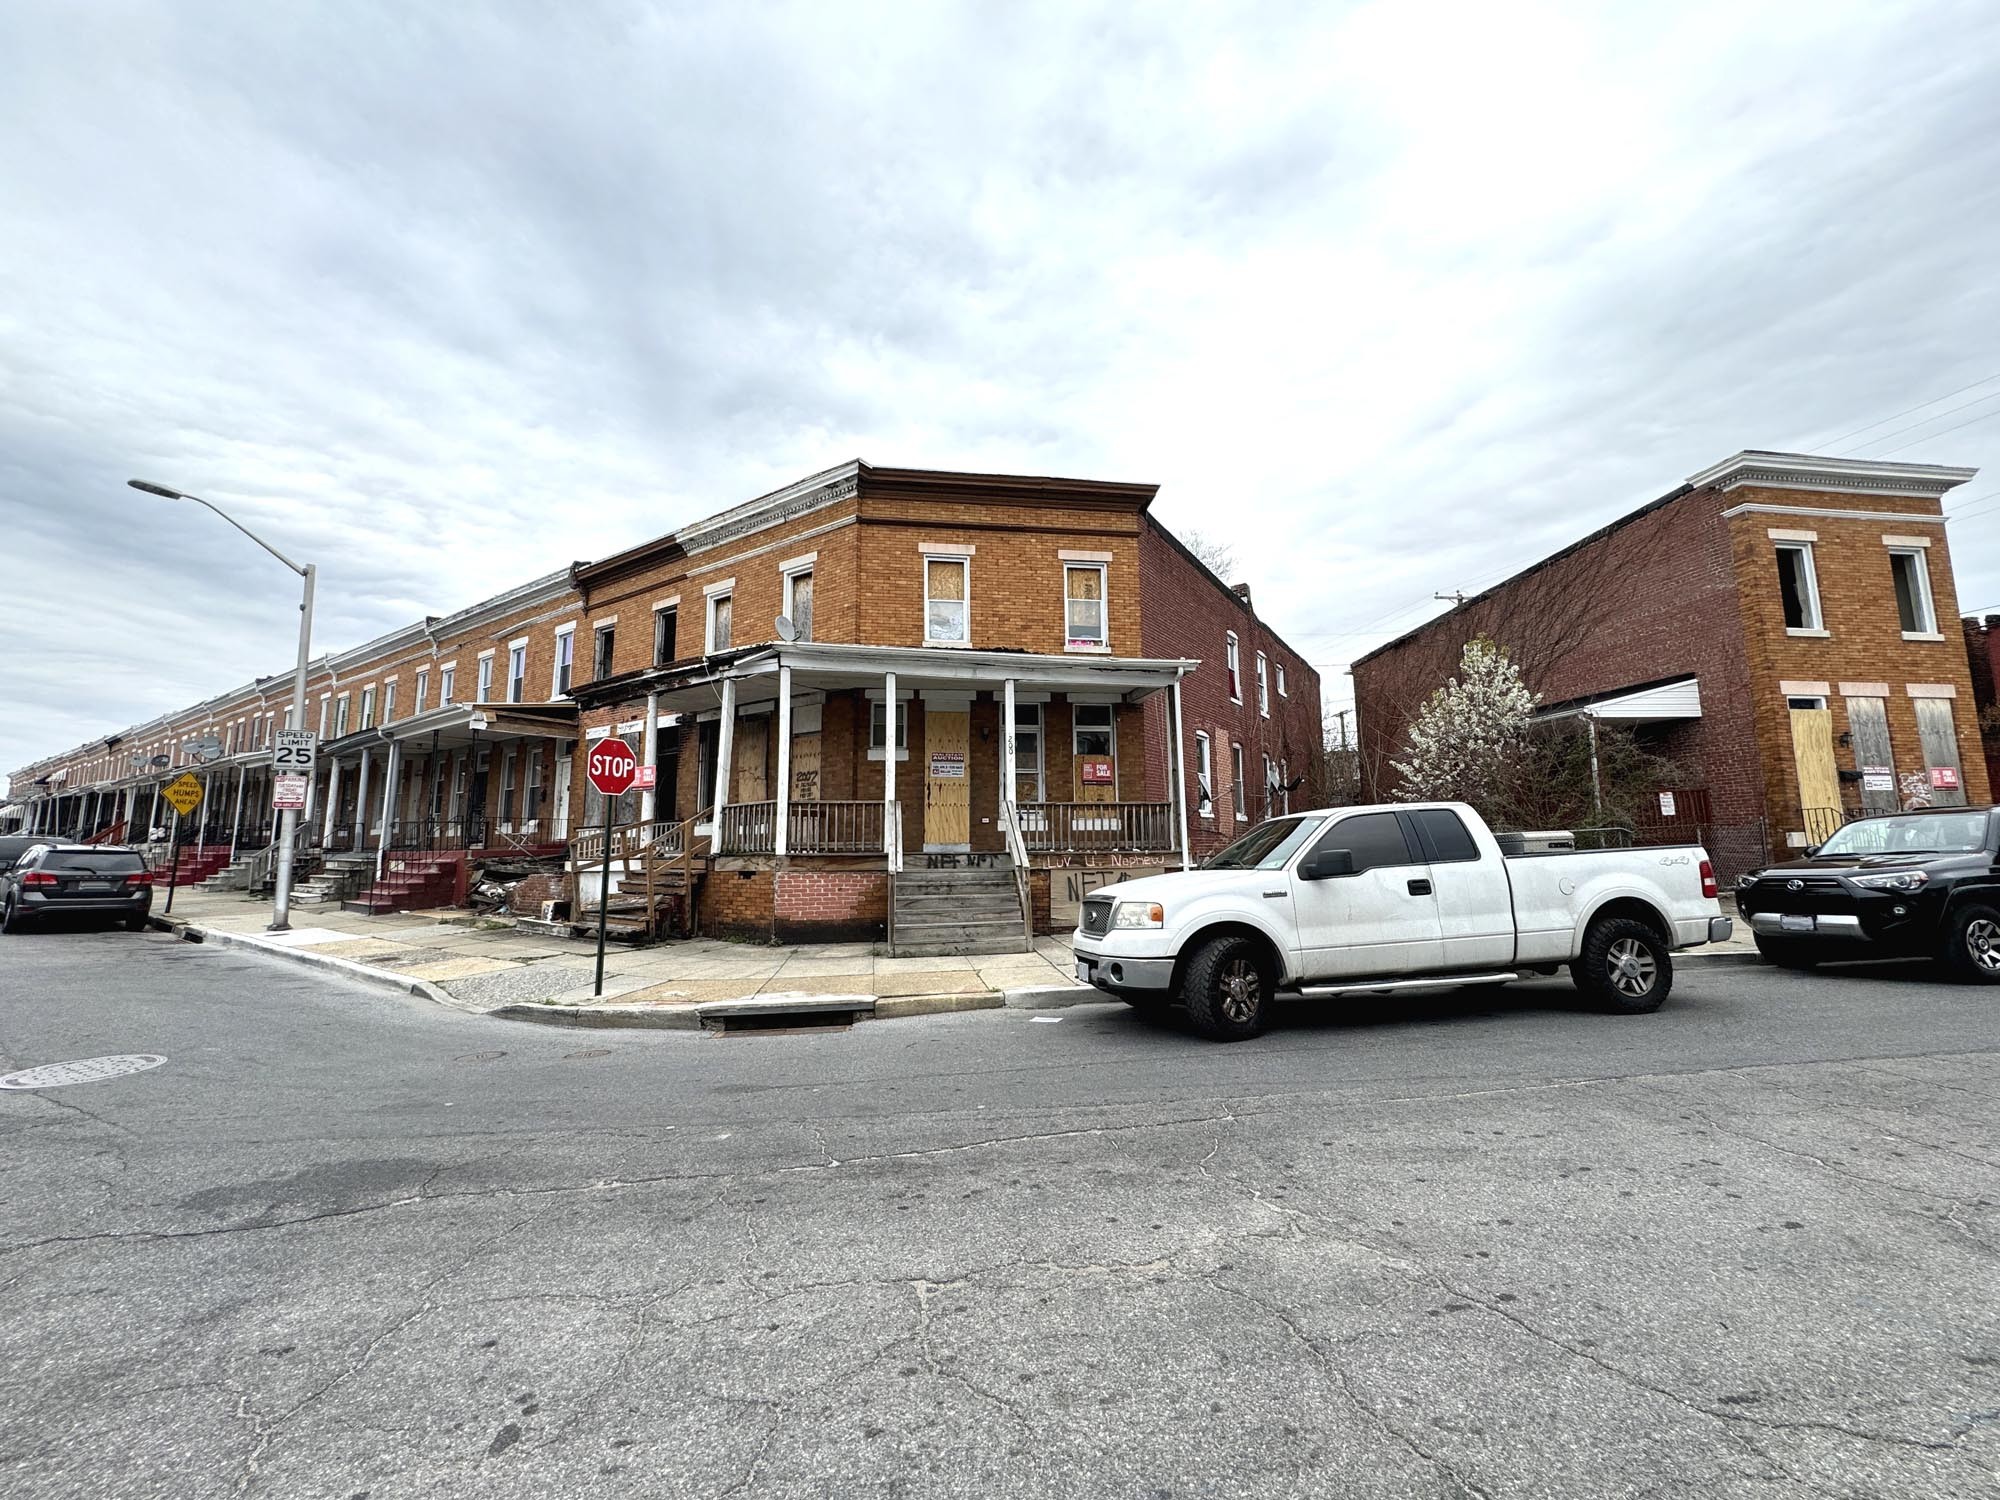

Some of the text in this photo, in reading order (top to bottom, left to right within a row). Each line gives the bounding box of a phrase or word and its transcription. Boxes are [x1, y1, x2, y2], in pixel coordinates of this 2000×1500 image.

[277, 731, 314, 739] SPEED
[276, 747, 312, 764] 25
[591, 754, 634, 778] STOP
[1096, 769, 1111, 777] SALE
[173, 789, 200, 798] HUMPS
[1043, 855, 1071, 869] Luv
